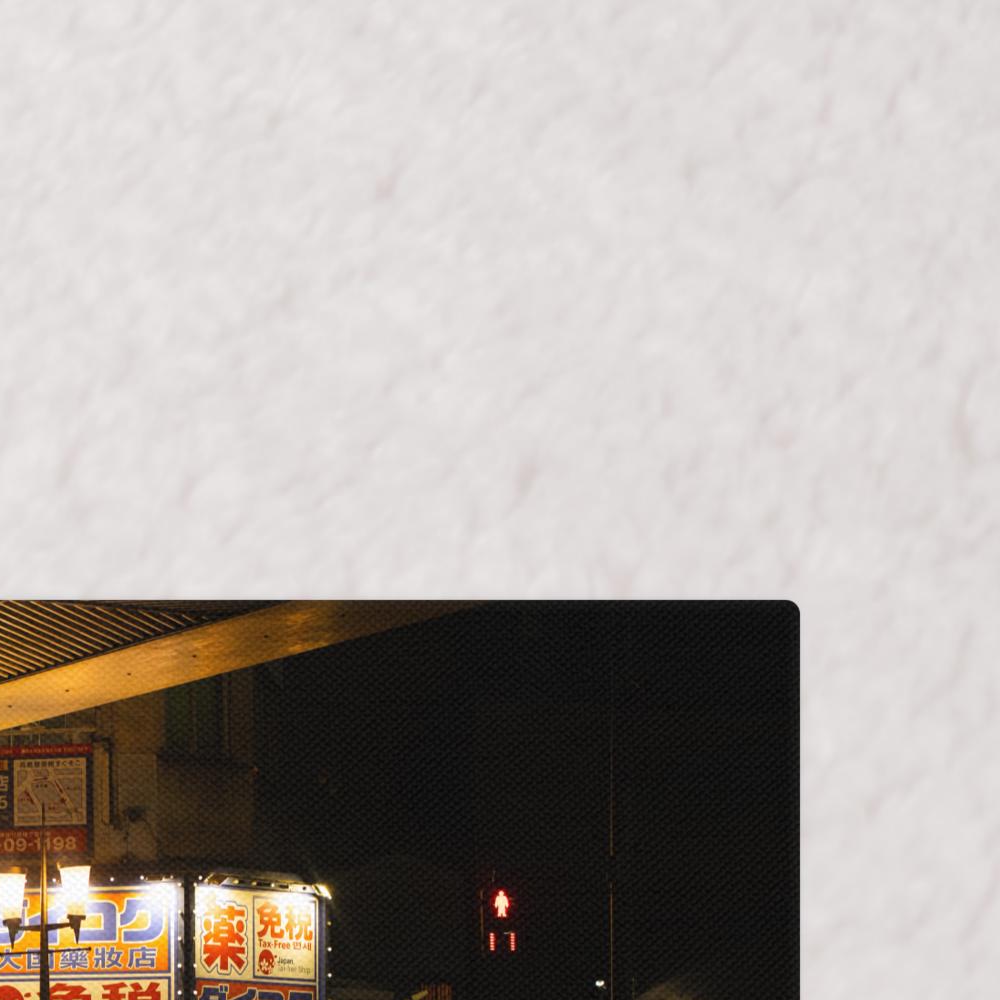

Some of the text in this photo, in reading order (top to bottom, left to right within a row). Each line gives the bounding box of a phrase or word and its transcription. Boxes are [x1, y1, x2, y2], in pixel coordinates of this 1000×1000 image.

[202, 905, 246, 971] 薬
[257, 900, 313, 941] 免税
[258, 938, 291, 950] Tax-Free
